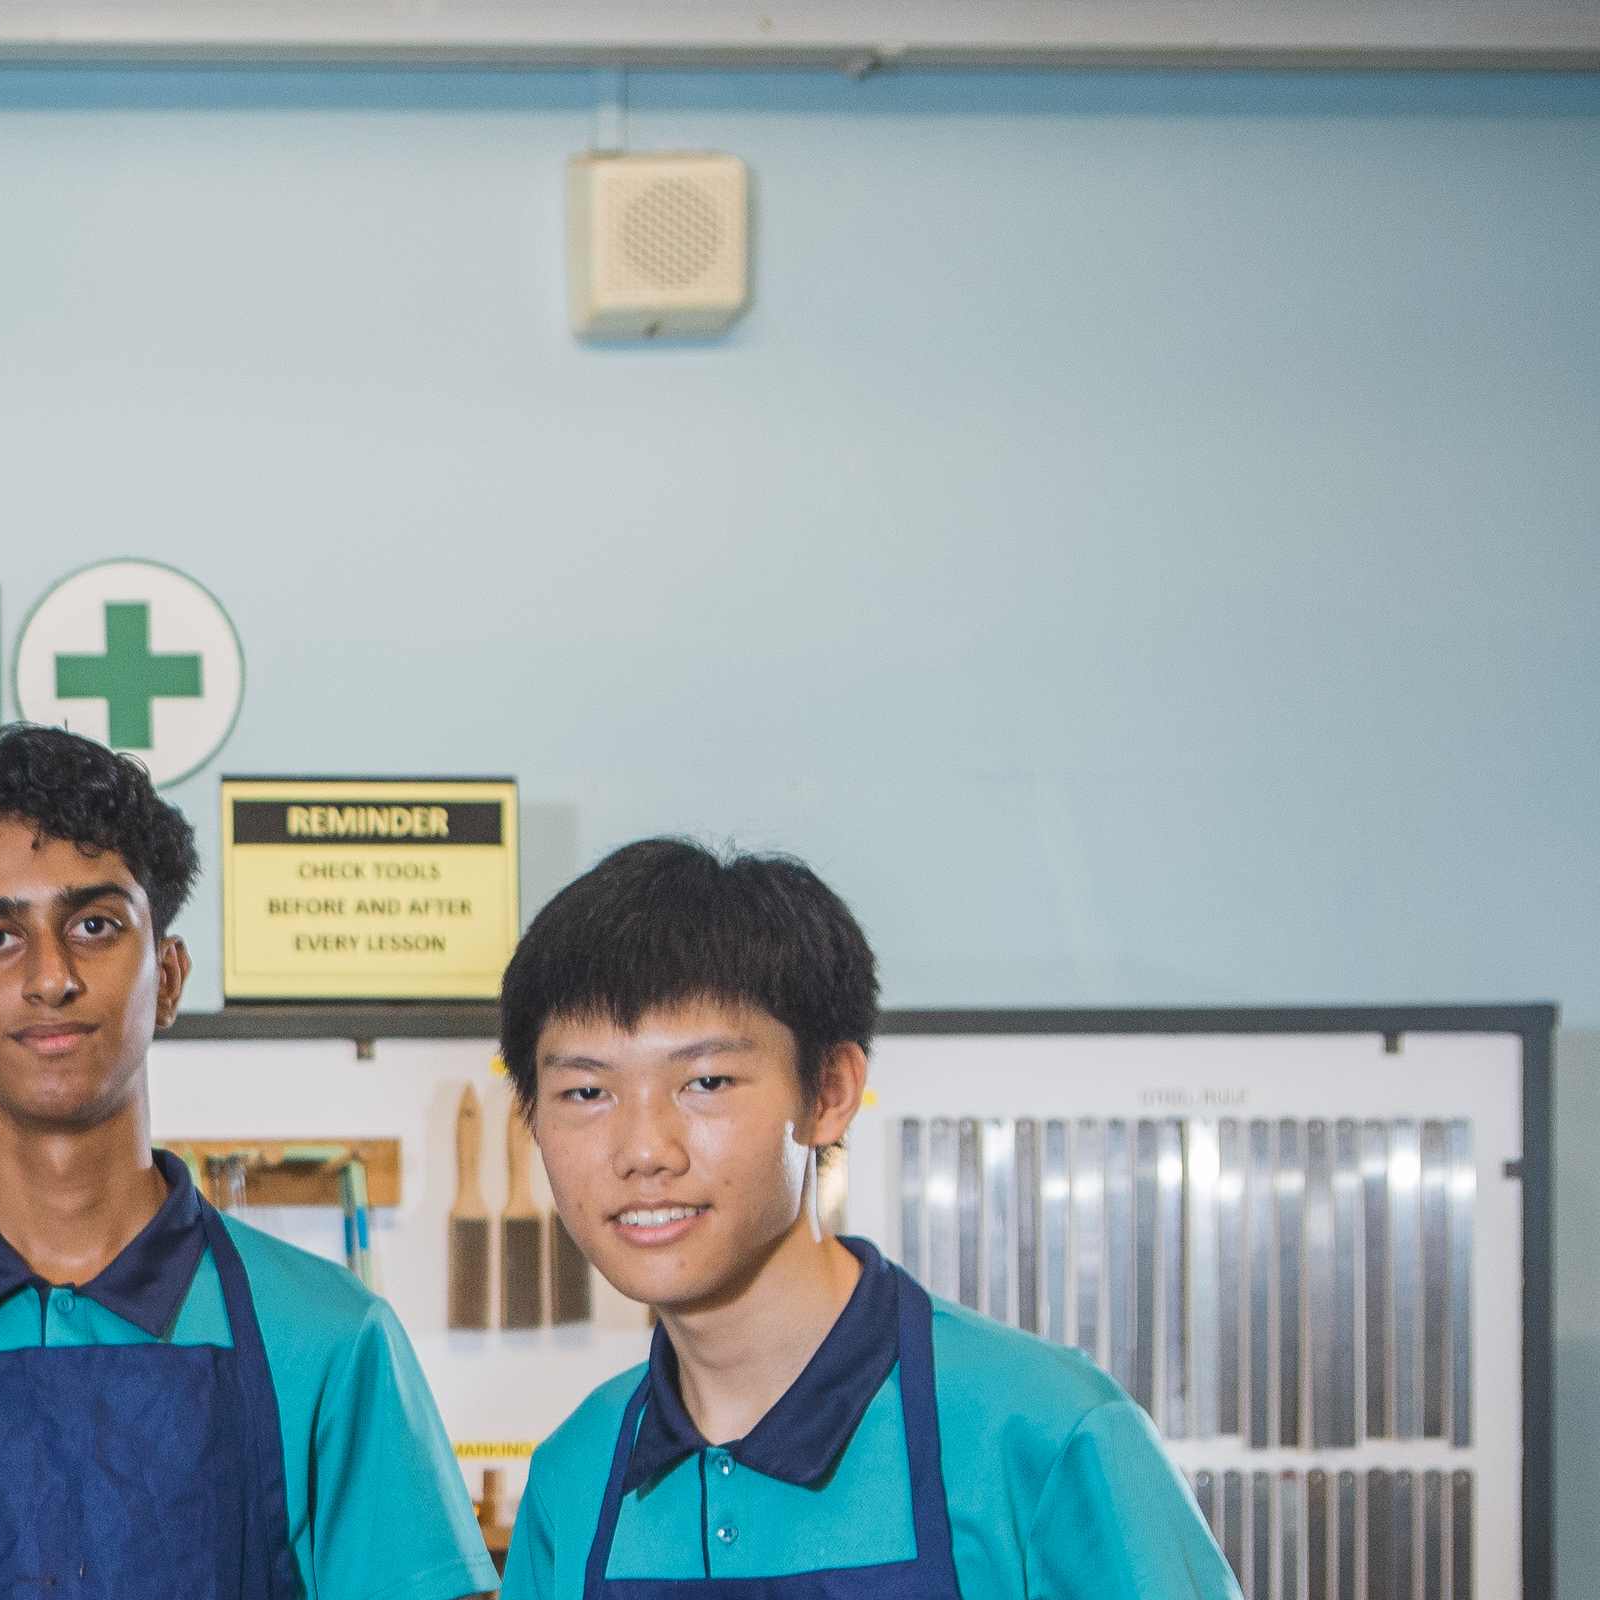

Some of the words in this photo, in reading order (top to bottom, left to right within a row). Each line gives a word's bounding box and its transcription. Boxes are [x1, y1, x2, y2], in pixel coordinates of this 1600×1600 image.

[287, 805, 450, 837] REMINDER
[297, 862, 365, 881] CHECK
[373, 861, 441, 881] TOOLS
[267, 898, 345, 916] BEFORE
[354, 898, 402, 916] AND
[408, 898, 473, 916] AFTER
[293, 934, 359, 953] EVERY
[366, 934, 447, 953] LESSON
